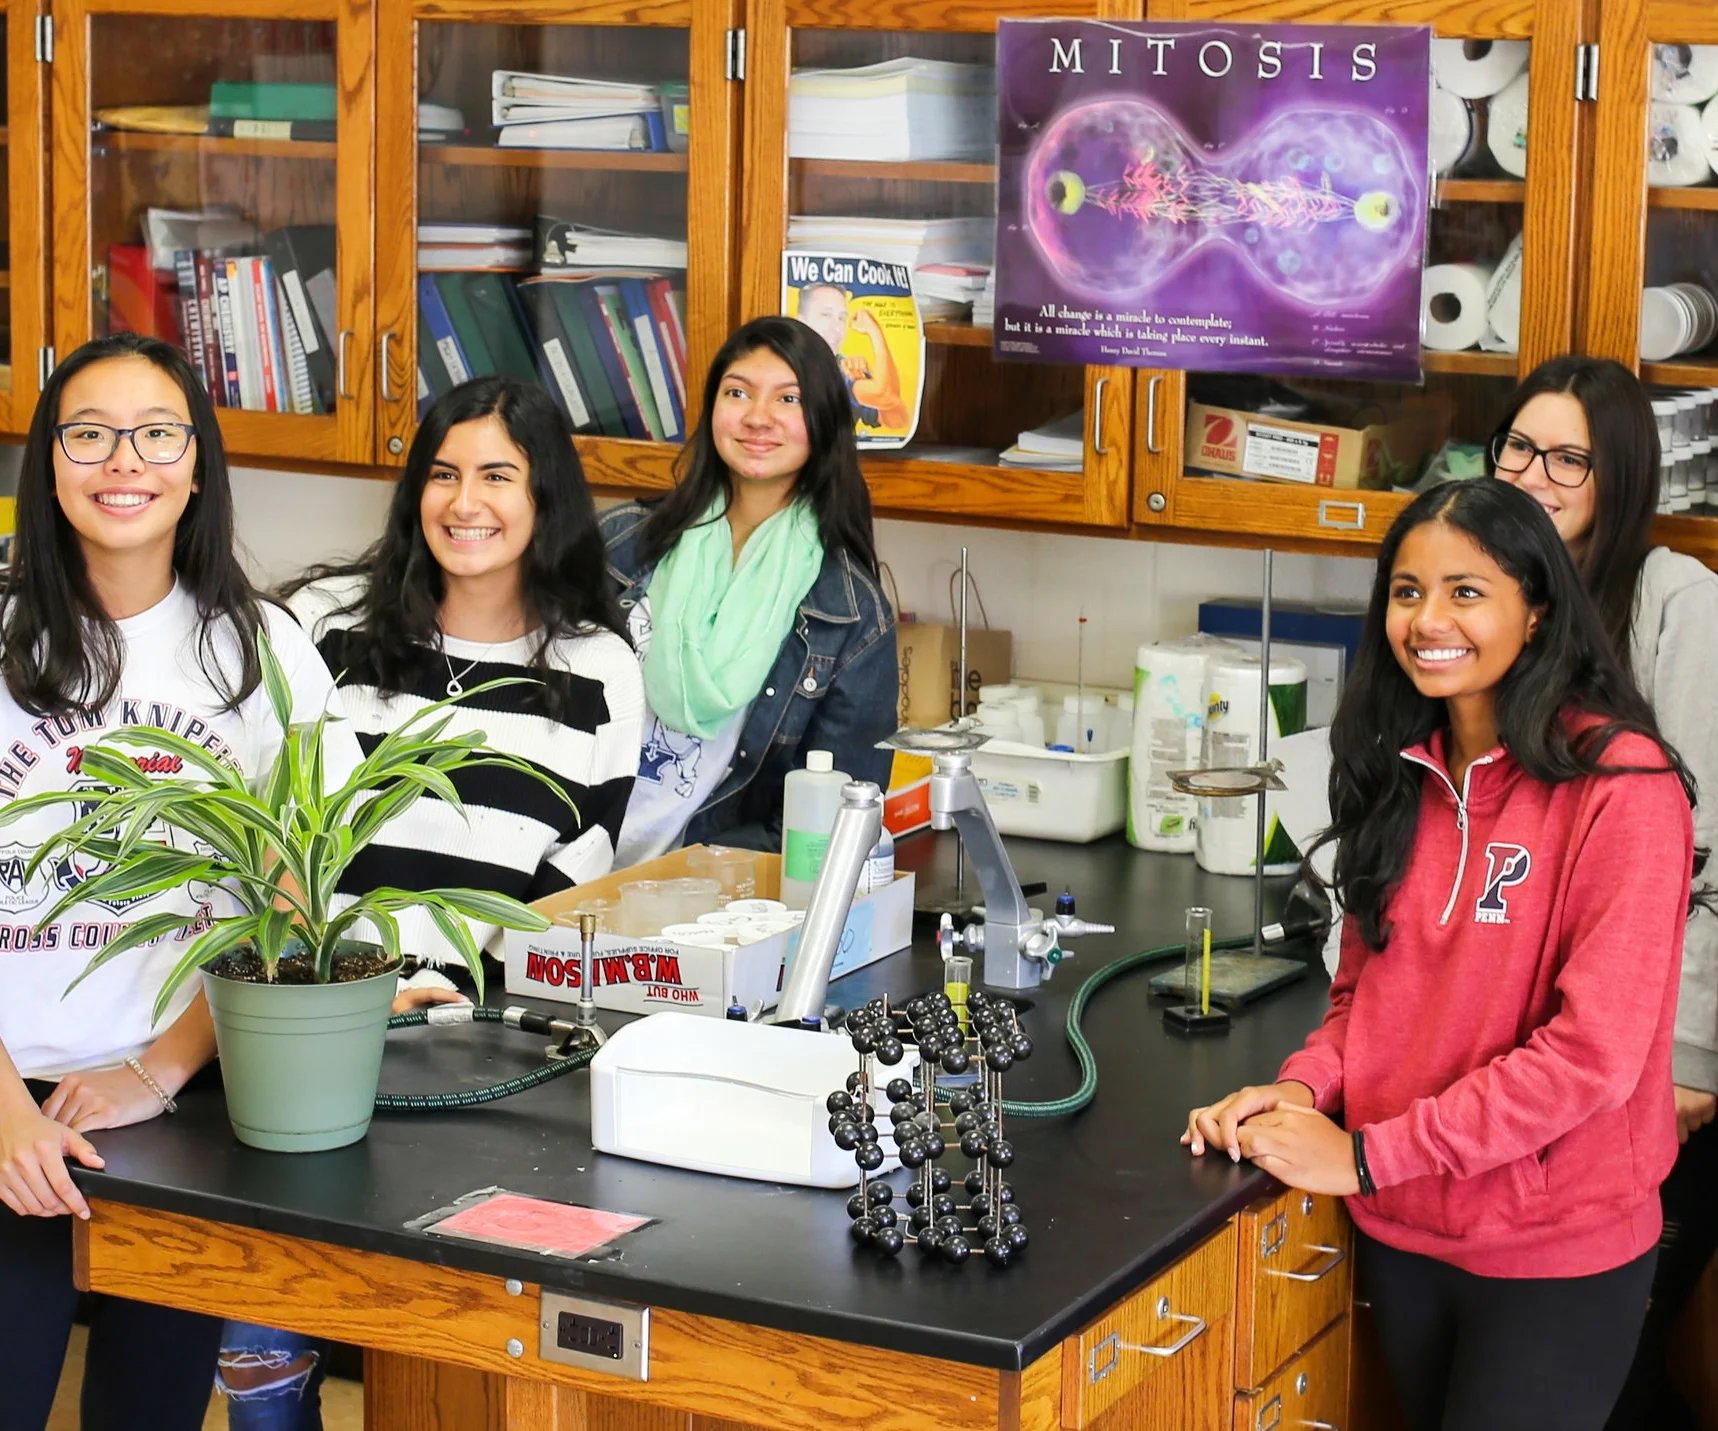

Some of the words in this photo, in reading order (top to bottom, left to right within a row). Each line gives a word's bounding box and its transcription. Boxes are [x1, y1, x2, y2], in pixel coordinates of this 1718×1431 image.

[1049, 38, 1377, 81] MITOSIS
[790, 256, 819, 282] We
[823, 257, 854, 283] Can
[857, 259, 894, 287] Cook
[892, 265, 910, 290] It!
[1039, 304, 1056, 319] All
[1058, 305, 1092, 322] change
[1095, 307, 1104, 321] is
[1106, 312, 1113, 322] a
[1116, 309, 1151, 324] miracle
[1154, 311, 1166, 325] to
[1168, 312, 1232, 330] contemplate;
[1004, 317, 1021, 333] but
[1024, 320, 1032, 333] it
[1035, 321, 1043, 334] is
[1055, 322, 1091, 337] miracle
[1094, 323, 1122, 338] which
[1125, 327, 1134, 340] is
[1136, 327, 1168, 344] taking
[1171, 329, 1197, 346] place
[1199, 333, 1227, 348] every
[1229, 332, 1269, 348] instant.
[1201, 445, 1236, 462] OHAUS
[31, 703, 107, 750] TOM
[1475, 841, 1532, 912] P
[1474, 912, 1505, 924] PENN
[0, 924, 61, 953] ROSS
[528, 944, 559, 957] PRINTING
[639, 945, 664, 954] OFFICE
[665, 947, 679, 955] FOR
[646, 985, 668, 998] BUT
[672, 989, 699, 1001] WHO
